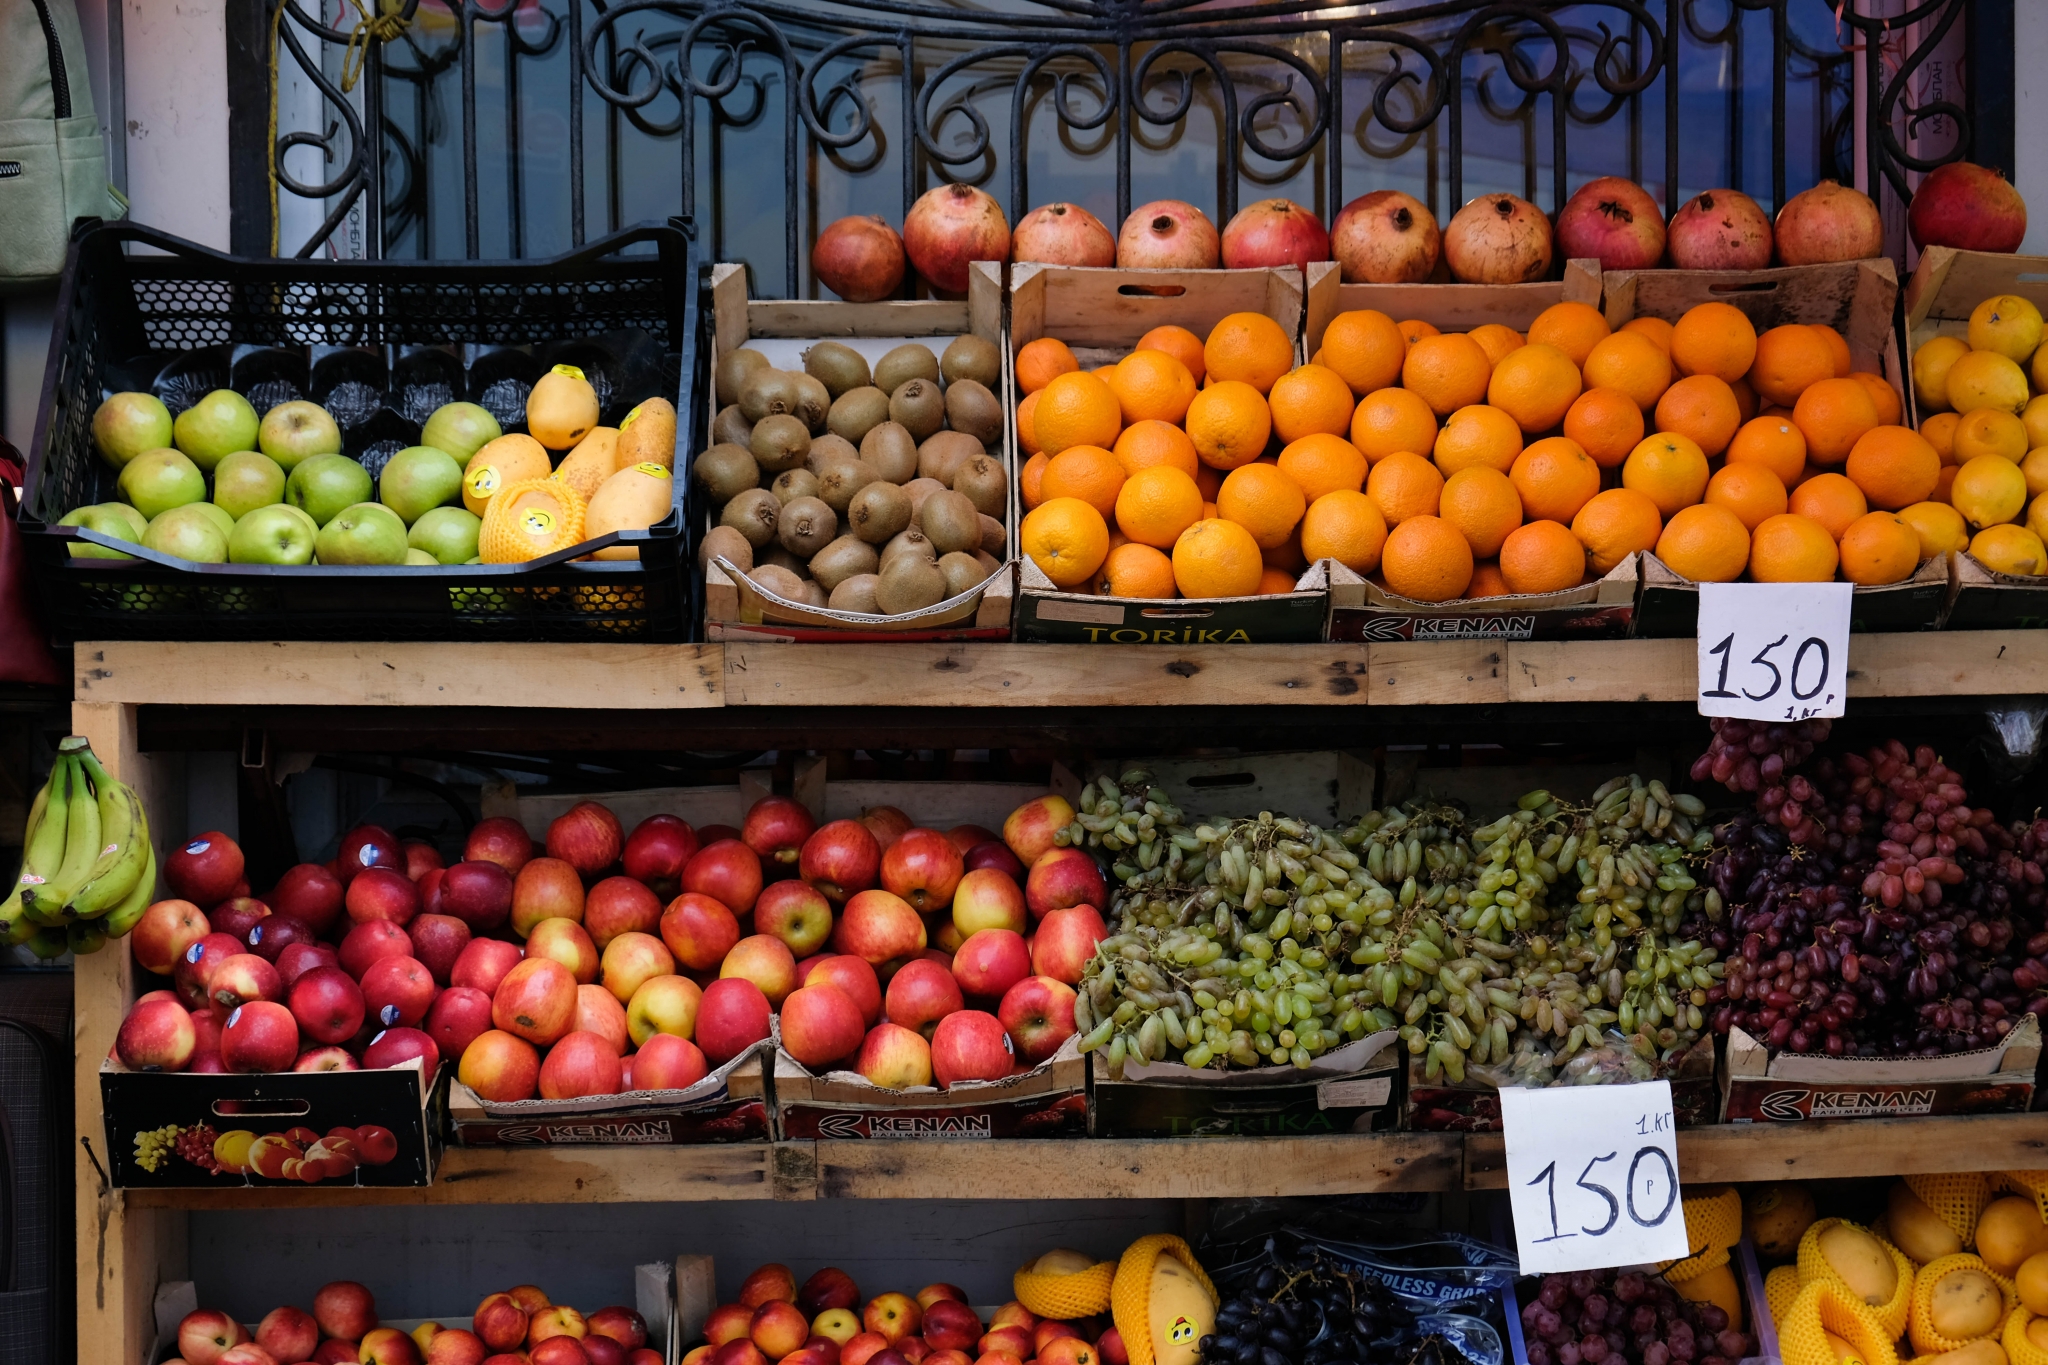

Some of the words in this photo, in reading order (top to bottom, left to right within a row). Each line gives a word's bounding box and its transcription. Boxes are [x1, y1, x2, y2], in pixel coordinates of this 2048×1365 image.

[1932, 61, 1943, 135] МОБЛАН
[1413, 616, 1536, 633] KENAN
[1701, 631, 1830, 702] 150
[1811, 1089, 1937, 1109] KENAN
[546, 1120, 672, 1138] KENAN
[868, 1114, 991, 1132] KENAN
[1526, 1145, 1679, 1243] 150
